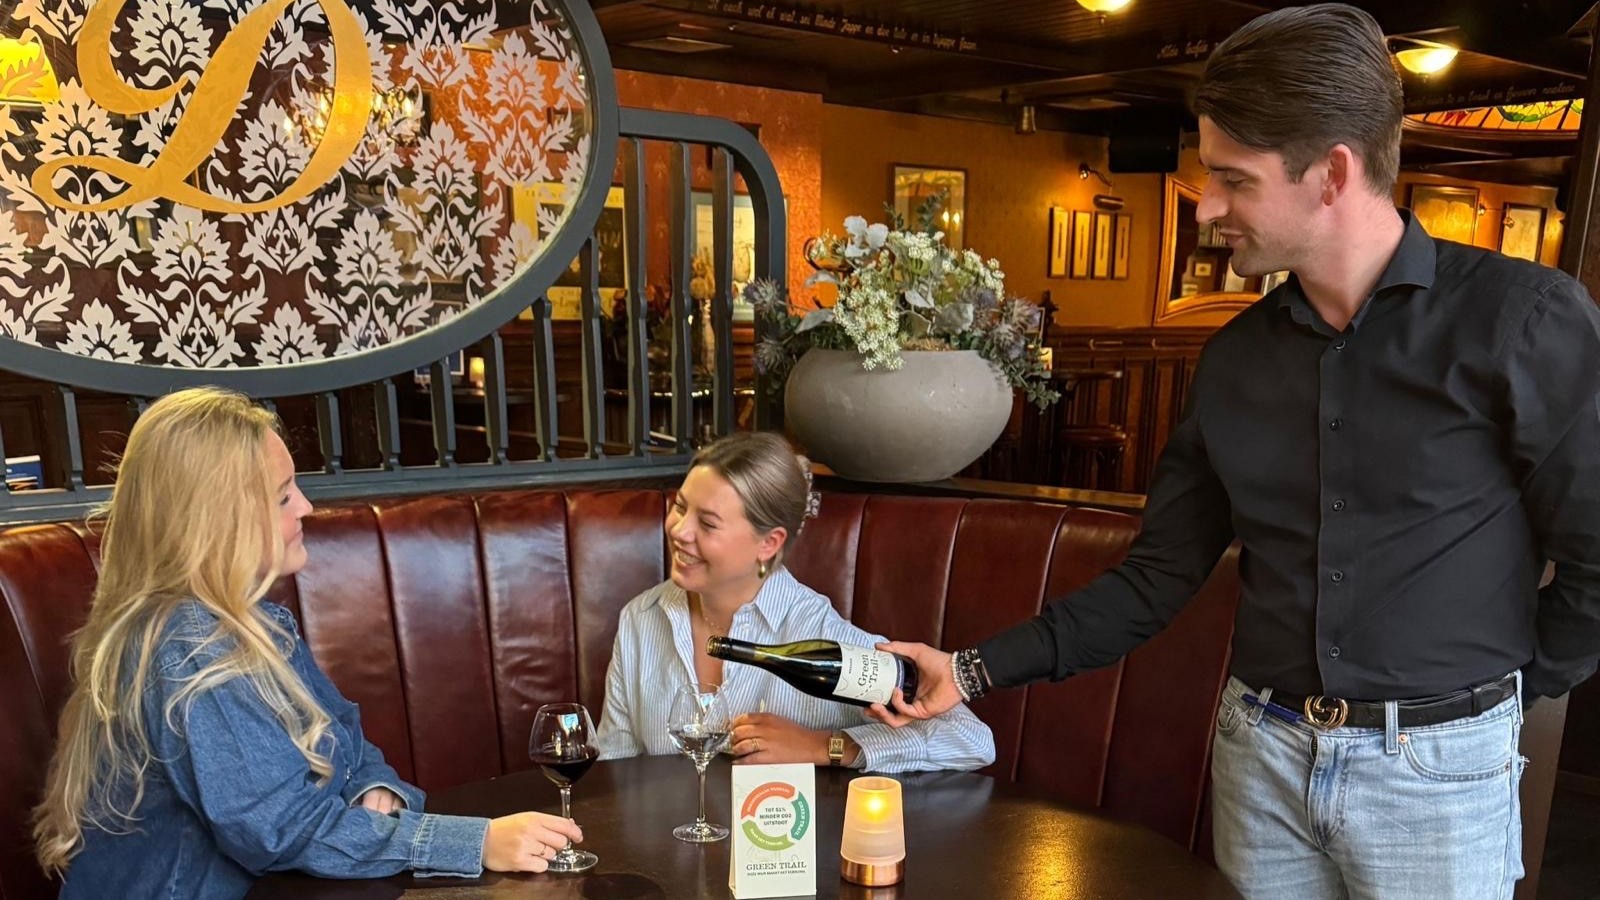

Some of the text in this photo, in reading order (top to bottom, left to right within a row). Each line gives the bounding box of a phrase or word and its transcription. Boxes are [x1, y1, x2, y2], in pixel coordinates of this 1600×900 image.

[857, 654, 869, 686] Green
[869, 659, 878, 683] Trail
[746, 861, 807, 871] GREEN TRAIL
